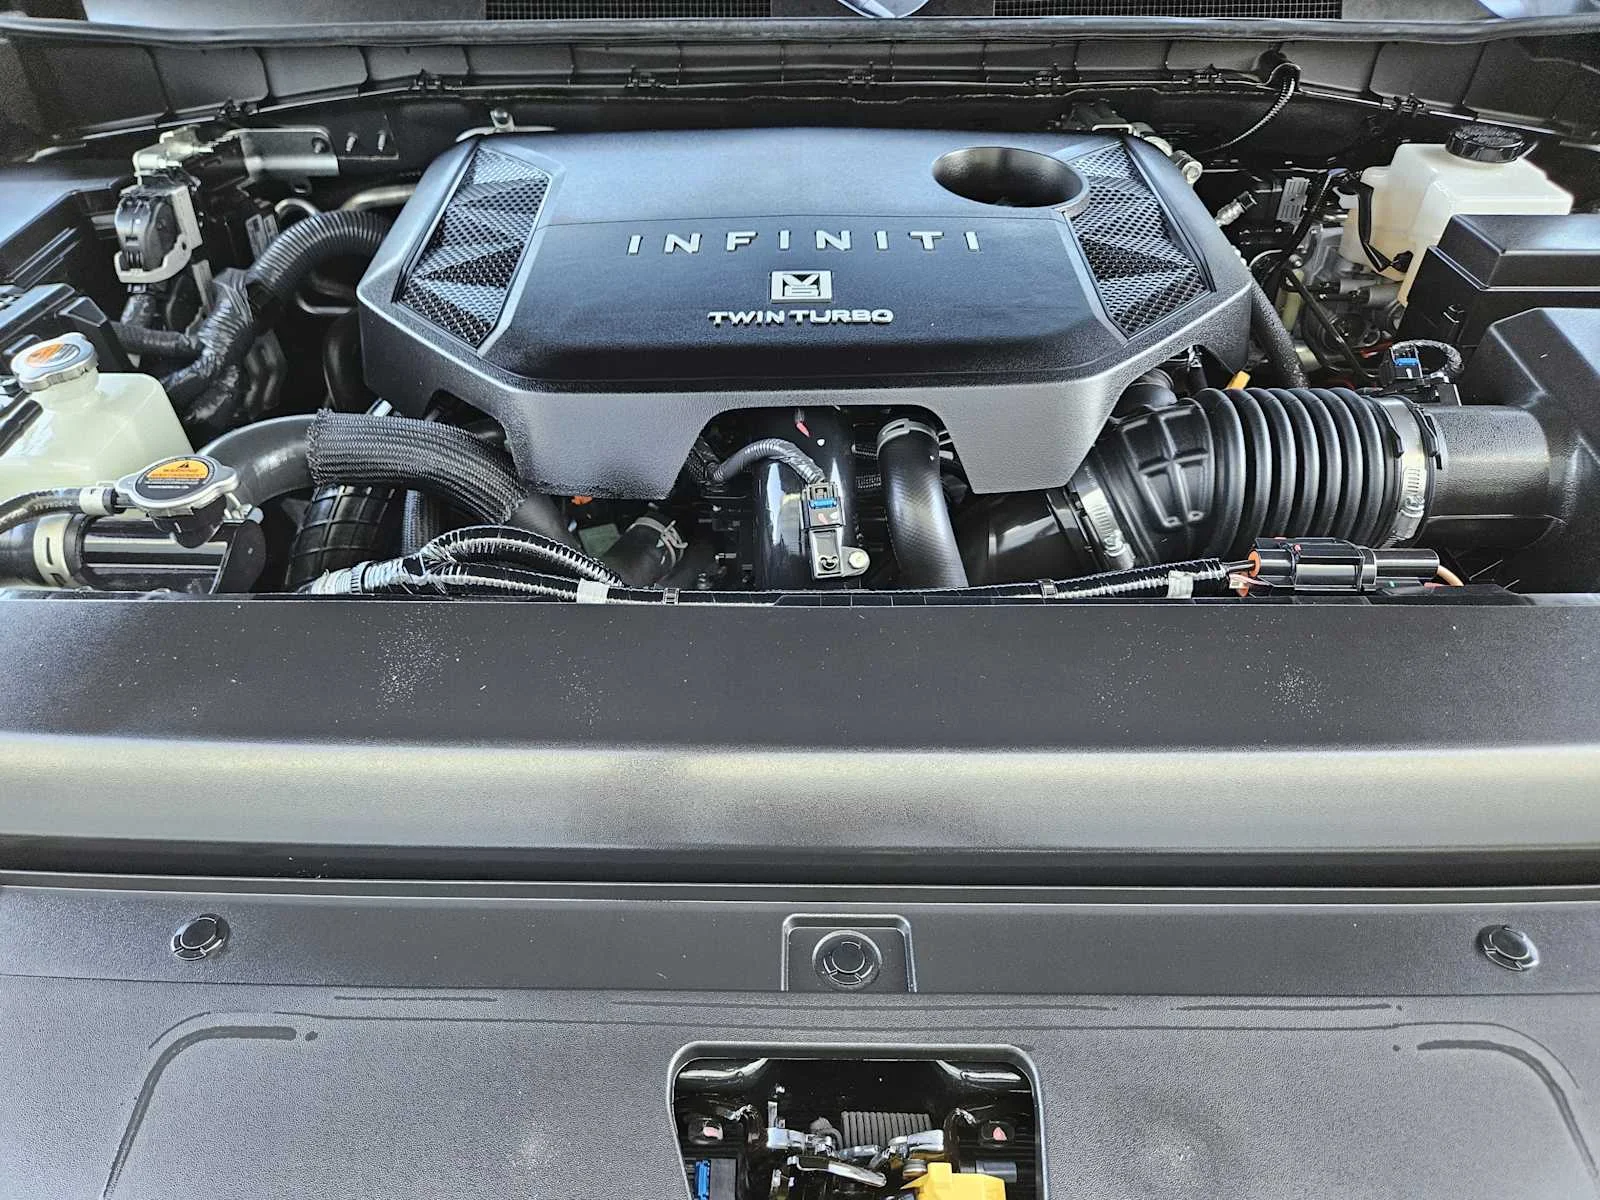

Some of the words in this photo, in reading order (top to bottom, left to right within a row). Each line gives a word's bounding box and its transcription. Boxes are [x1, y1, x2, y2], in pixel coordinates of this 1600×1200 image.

[628, 230, 981, 255] INFINITI
[707, 310, 785, 326] TWIN
[789, 309, 894, 325] TURBO
